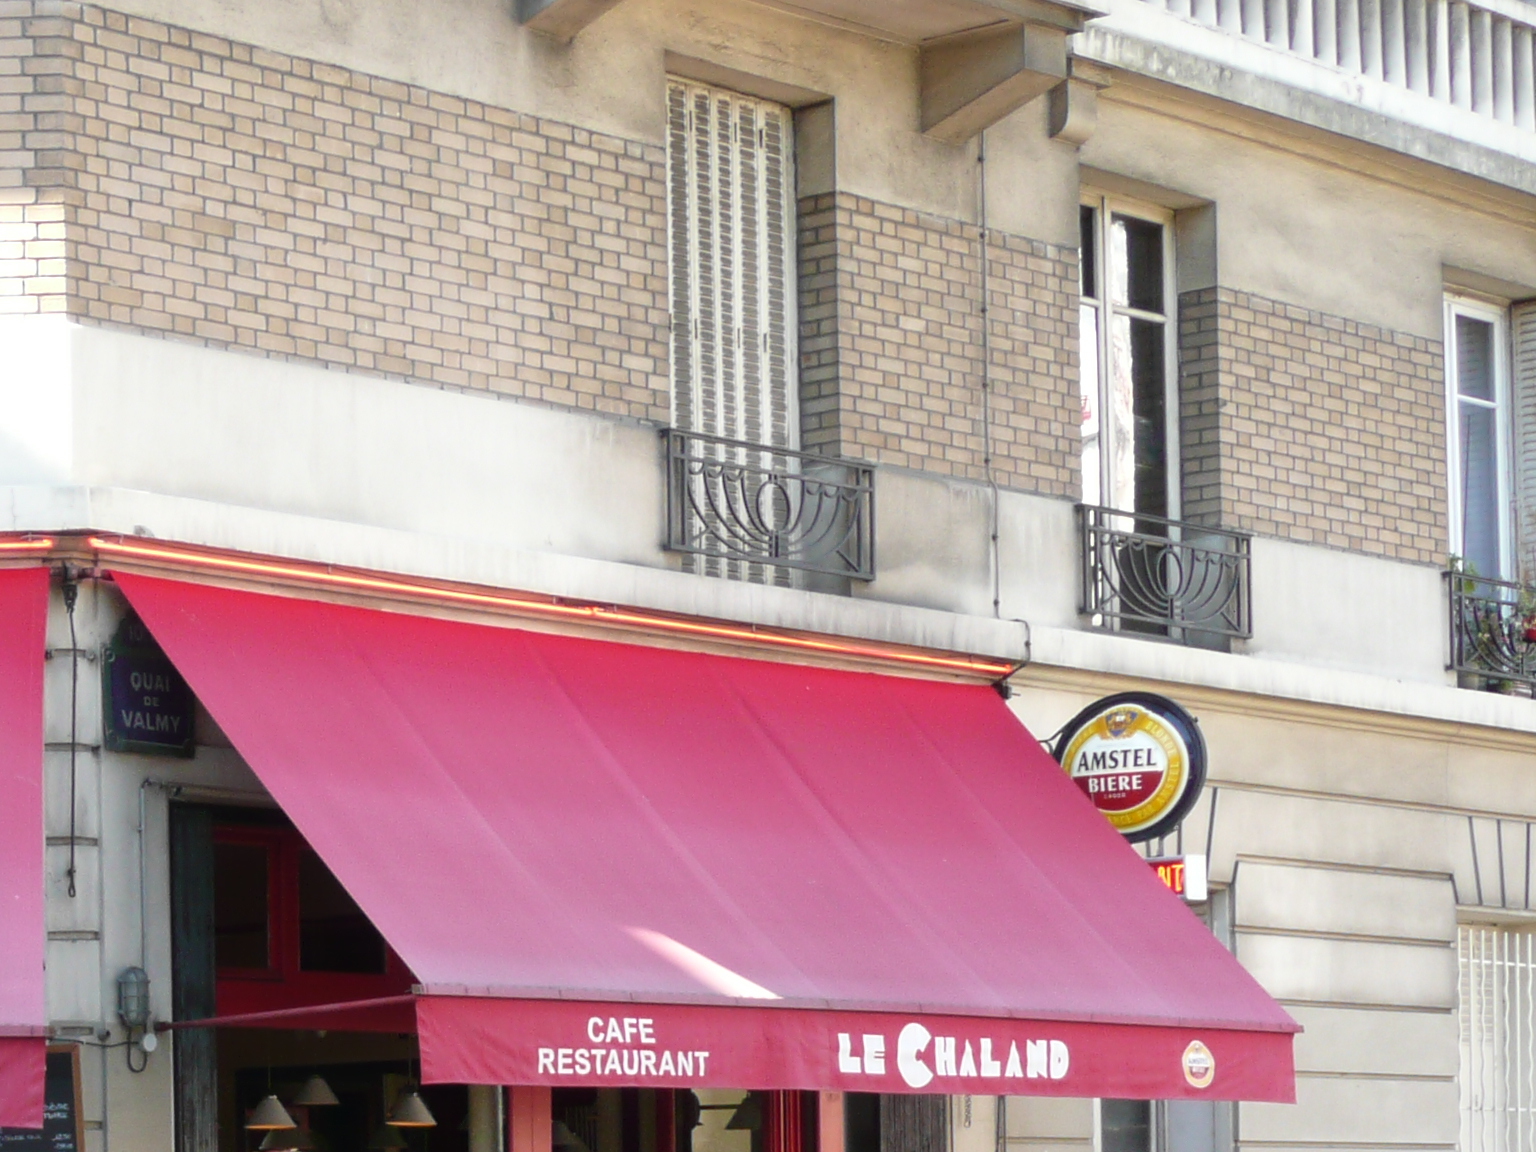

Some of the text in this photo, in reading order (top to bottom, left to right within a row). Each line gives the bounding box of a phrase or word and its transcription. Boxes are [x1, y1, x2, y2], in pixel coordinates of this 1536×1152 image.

[130, 672, 170, 692] QUAI
[143, 695, 160, 707] DE
[121, 709, 181, 733] VALMY
[1077, 747, 1158, 774] AMSTEL
[1088, 774, 1143, 794] BIERE
[587, 1016, 657, 1045] CAFE
[537, 1047, 710, 1078] RESTAURANT
[837, 1021, 1070, 1089] LE CHALAND
